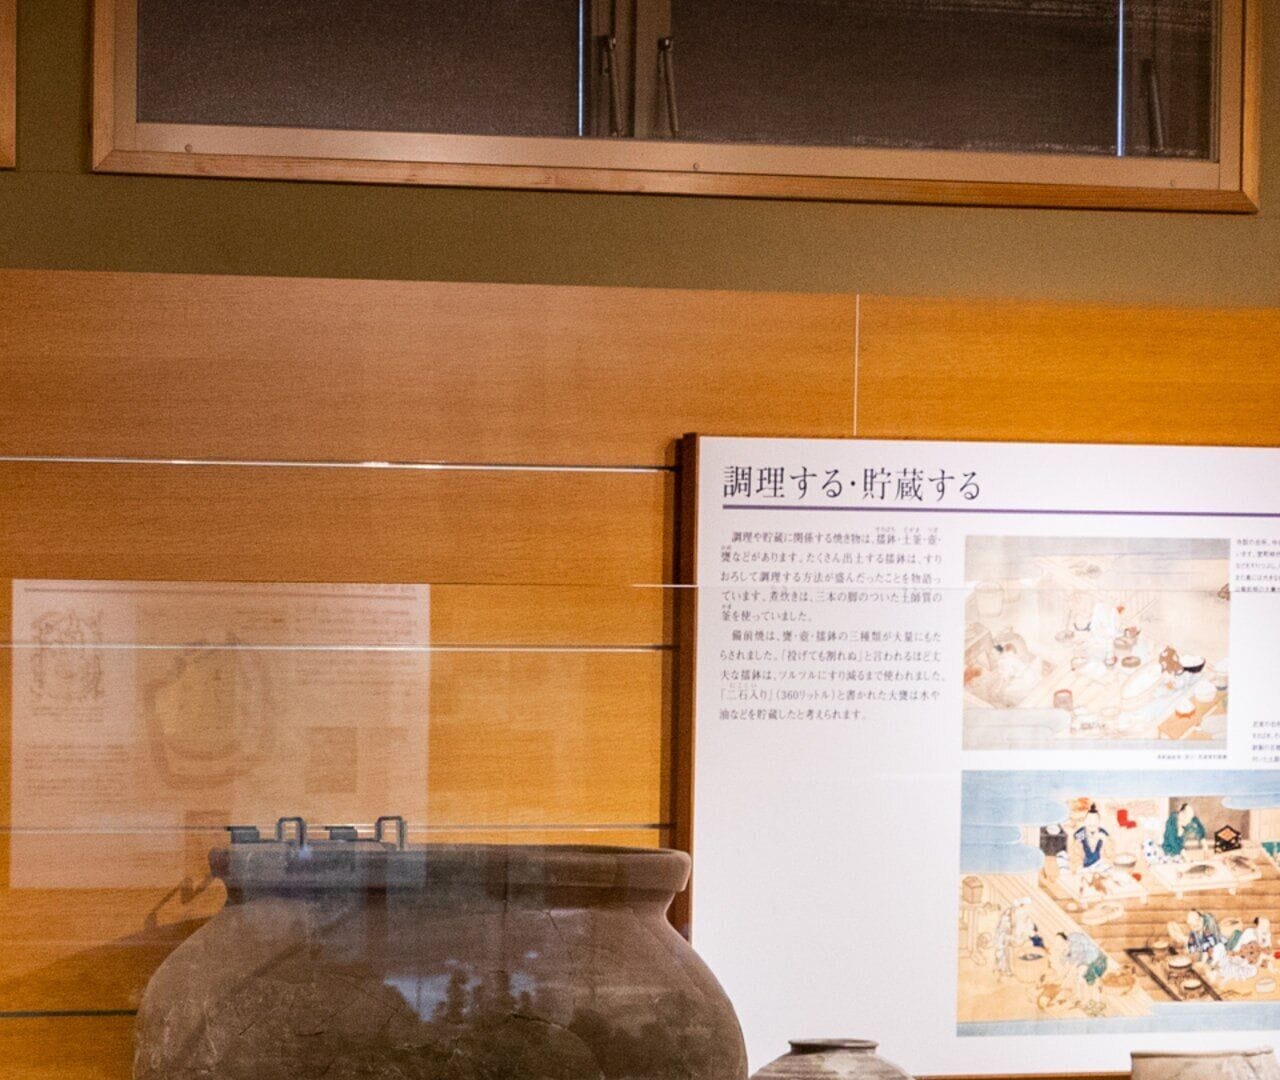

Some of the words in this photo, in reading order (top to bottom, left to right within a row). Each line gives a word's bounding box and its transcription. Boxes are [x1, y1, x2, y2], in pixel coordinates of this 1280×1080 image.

[722, 465, 981, 501] 調理する・貯蔵する
